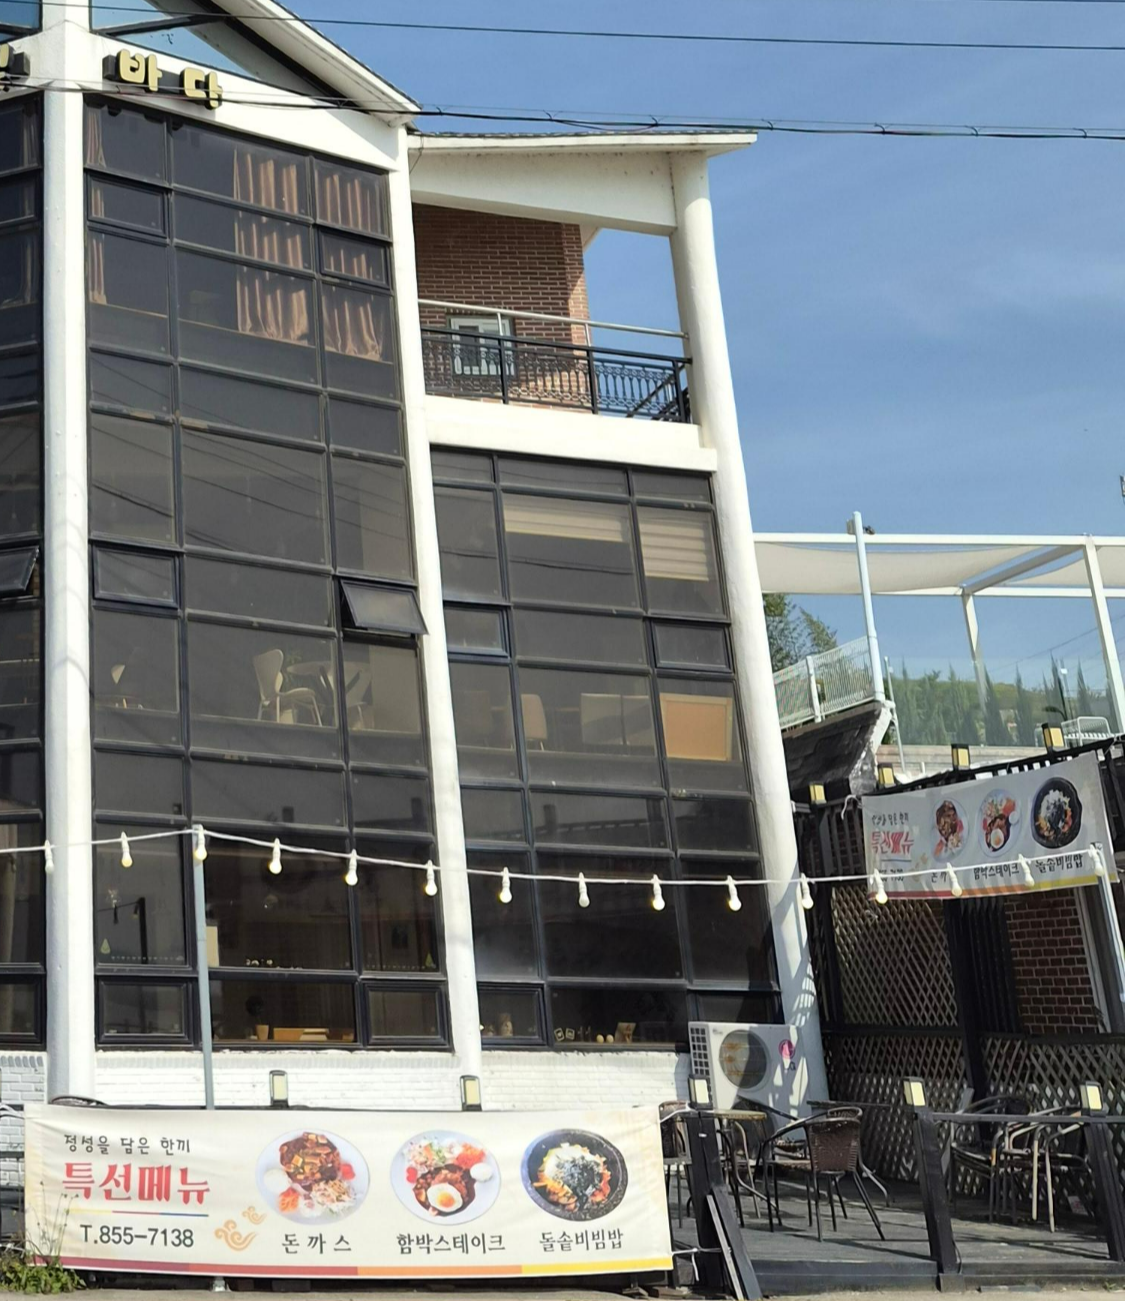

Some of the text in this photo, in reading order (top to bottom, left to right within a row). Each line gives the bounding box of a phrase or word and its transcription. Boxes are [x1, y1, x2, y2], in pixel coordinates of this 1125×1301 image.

[118, 49, 224, 111] 바다
[64, 1134, 191, 1156] 정성을 담은 한끼
[62, 1162, 211, 1205] 특선메뉴
[79, 1224, 194, 1248] T.855-7138
[281, 1232, 352, 1255] 돈까스
[395, 1232, 506, 1255] 함박스테이크
[538, 1228, 624, 1253] 돌솥비빔밥
